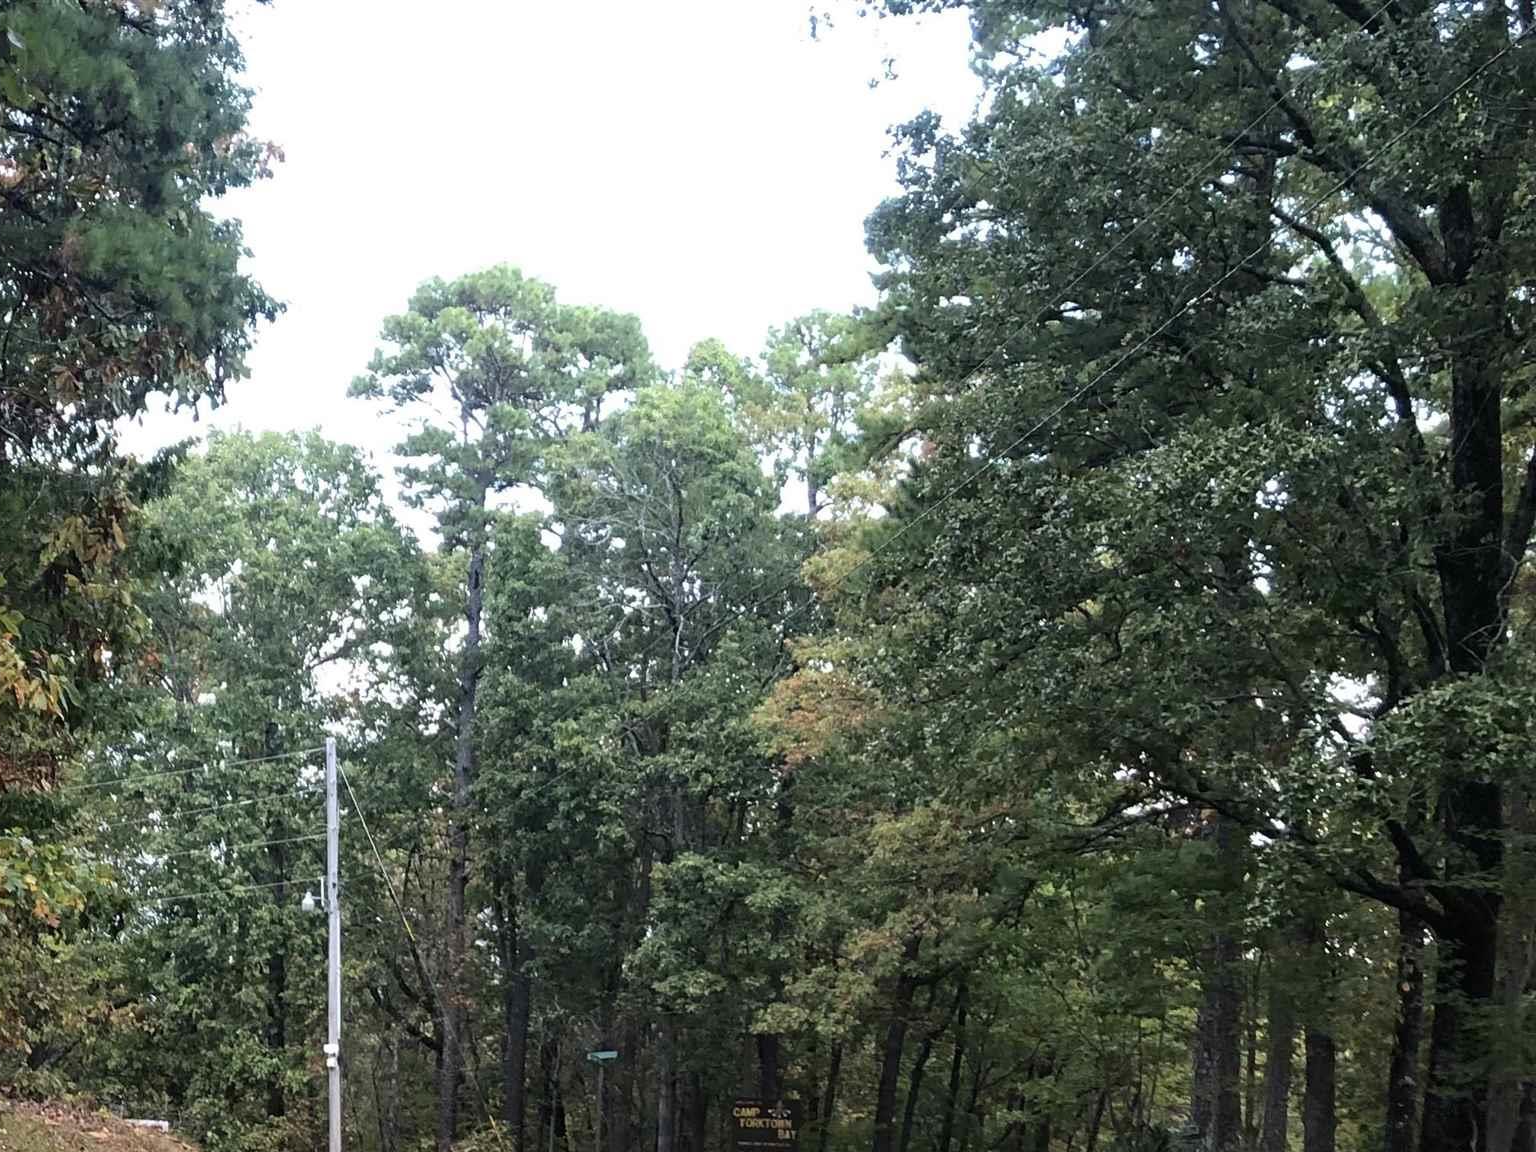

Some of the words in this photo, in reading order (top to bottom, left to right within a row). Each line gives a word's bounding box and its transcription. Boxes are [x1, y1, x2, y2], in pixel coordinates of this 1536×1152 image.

[732, 1107, 761, 1117] CAMP
[739, 1118, 793, 1129] YORKTOWN
[777, 1128, 798, 1139] BAY
